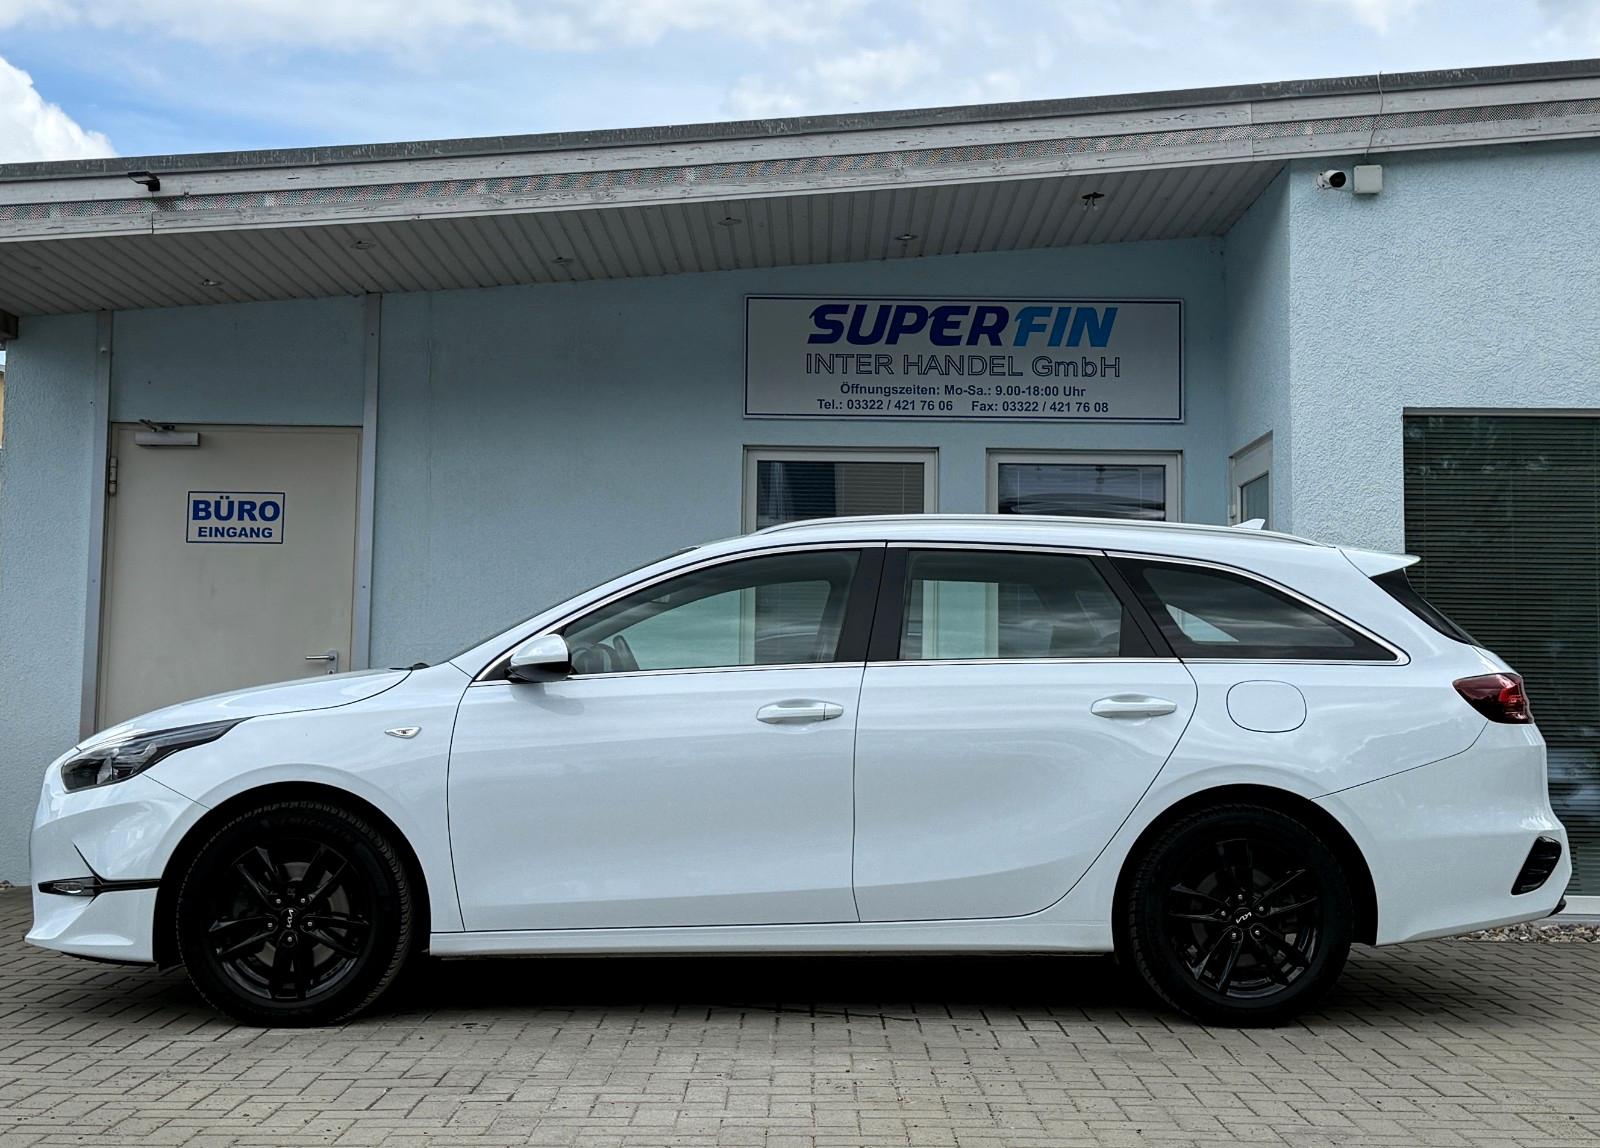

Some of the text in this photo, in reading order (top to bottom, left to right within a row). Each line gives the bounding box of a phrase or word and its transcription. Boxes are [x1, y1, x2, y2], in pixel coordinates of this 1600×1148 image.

[806, 353, 1121, 378] INTER HANDEL GmbH
[840, 382, 1087, 397] Öffnungszeiten: Mo-Sa.: 9.00-18:00 Uhr
[817, 399, 843, 410] Tel.:
[847, 400, 884, 410] 03322
[894, 400, 916, 411] 421
[920, 401, 935, 411] 76
[938, 401, 953, 411] 06
[971, 401, 998, 412] Fax:
[1002, 401, 1039, 412] 03322
[1050, 402, 1071, 412] 421
[1076, 402, 1091, 412] 76
[1094, 402, 1109, 413] 08
[192, 495, 281, 522] BÜRO
[198, 526, 273, 539] EINGANG
